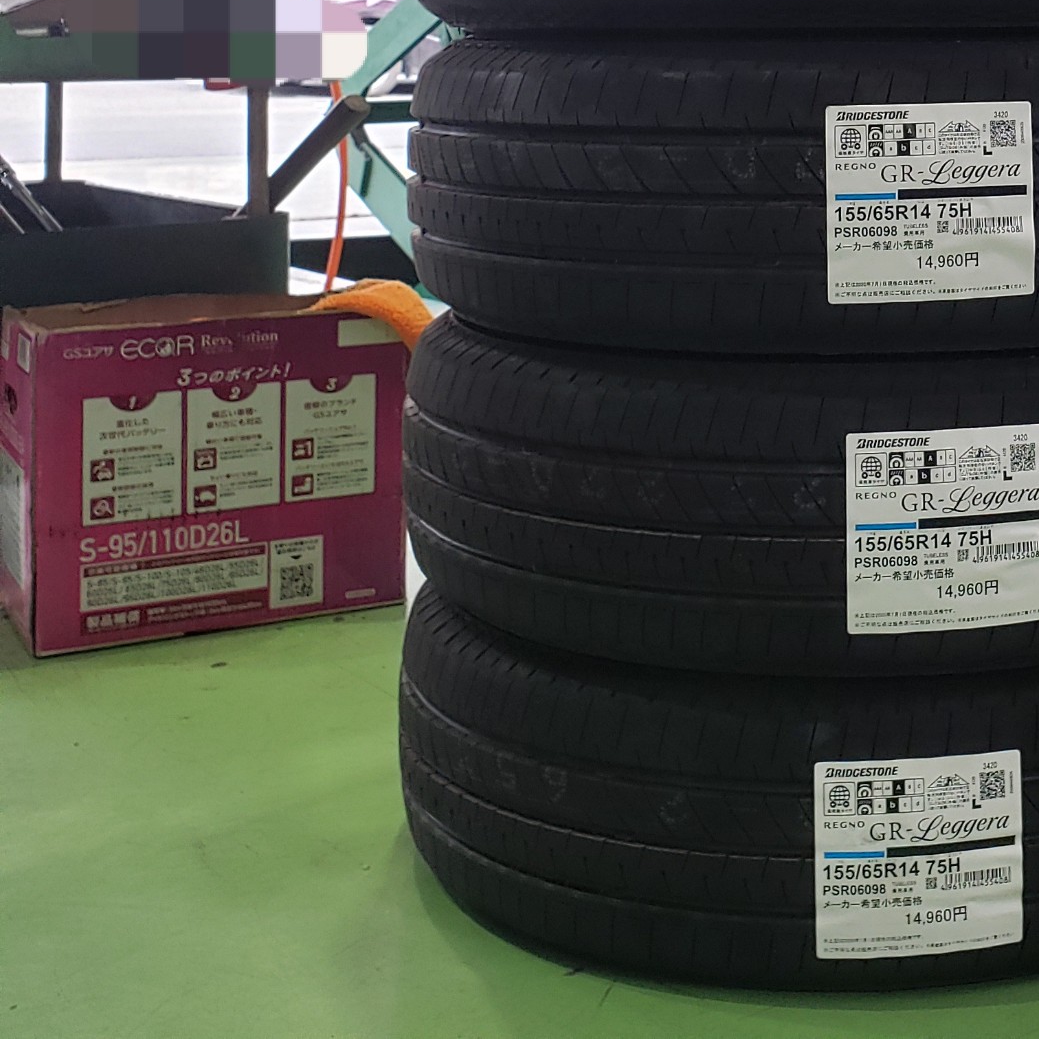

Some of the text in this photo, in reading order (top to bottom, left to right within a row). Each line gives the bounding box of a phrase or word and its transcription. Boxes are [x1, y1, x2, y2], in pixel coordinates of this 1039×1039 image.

[835, 111, 910, 122] BRIDGESTONE
[835, 162, 877, 171] REGNO
[880, 158, 1021, 186] GR-Leggera
[834, 203, 972, 222] 155/65R14 75H
[834, 226, 898, 238] PSR06098
[834, 240, 934, 252] メーカー希望小売価格
[917, 252, 979, 270] 14,960円
[326, 377, 338, 391] 3
[856, 437, 931, 449] BRIDGESTONE
[855, 491, 897, 500] REGNO
[79, 520, 249, 562] S-95/110D26L
[854, 530, 992, 553] 155/65R14 75H
[854, 556, 918, 568] PSR06098
[854, 568, 954, 582] メーカー希望小売価格
[937, 580, 999, 599] 14,960円
[824, 766, 899, 778] BRIDGESTONE
[824, 821, 865, 829] REGNO
[869, 815, 1010, 843] GR-Leggera
[823, 857, 961, 880] 155/65R14 75H
[823, 883, 886, 896] PSR06098
[823, 897, 922, 909] メーカー希望小売価格
[905, 906, 967, 925] 14,960円
